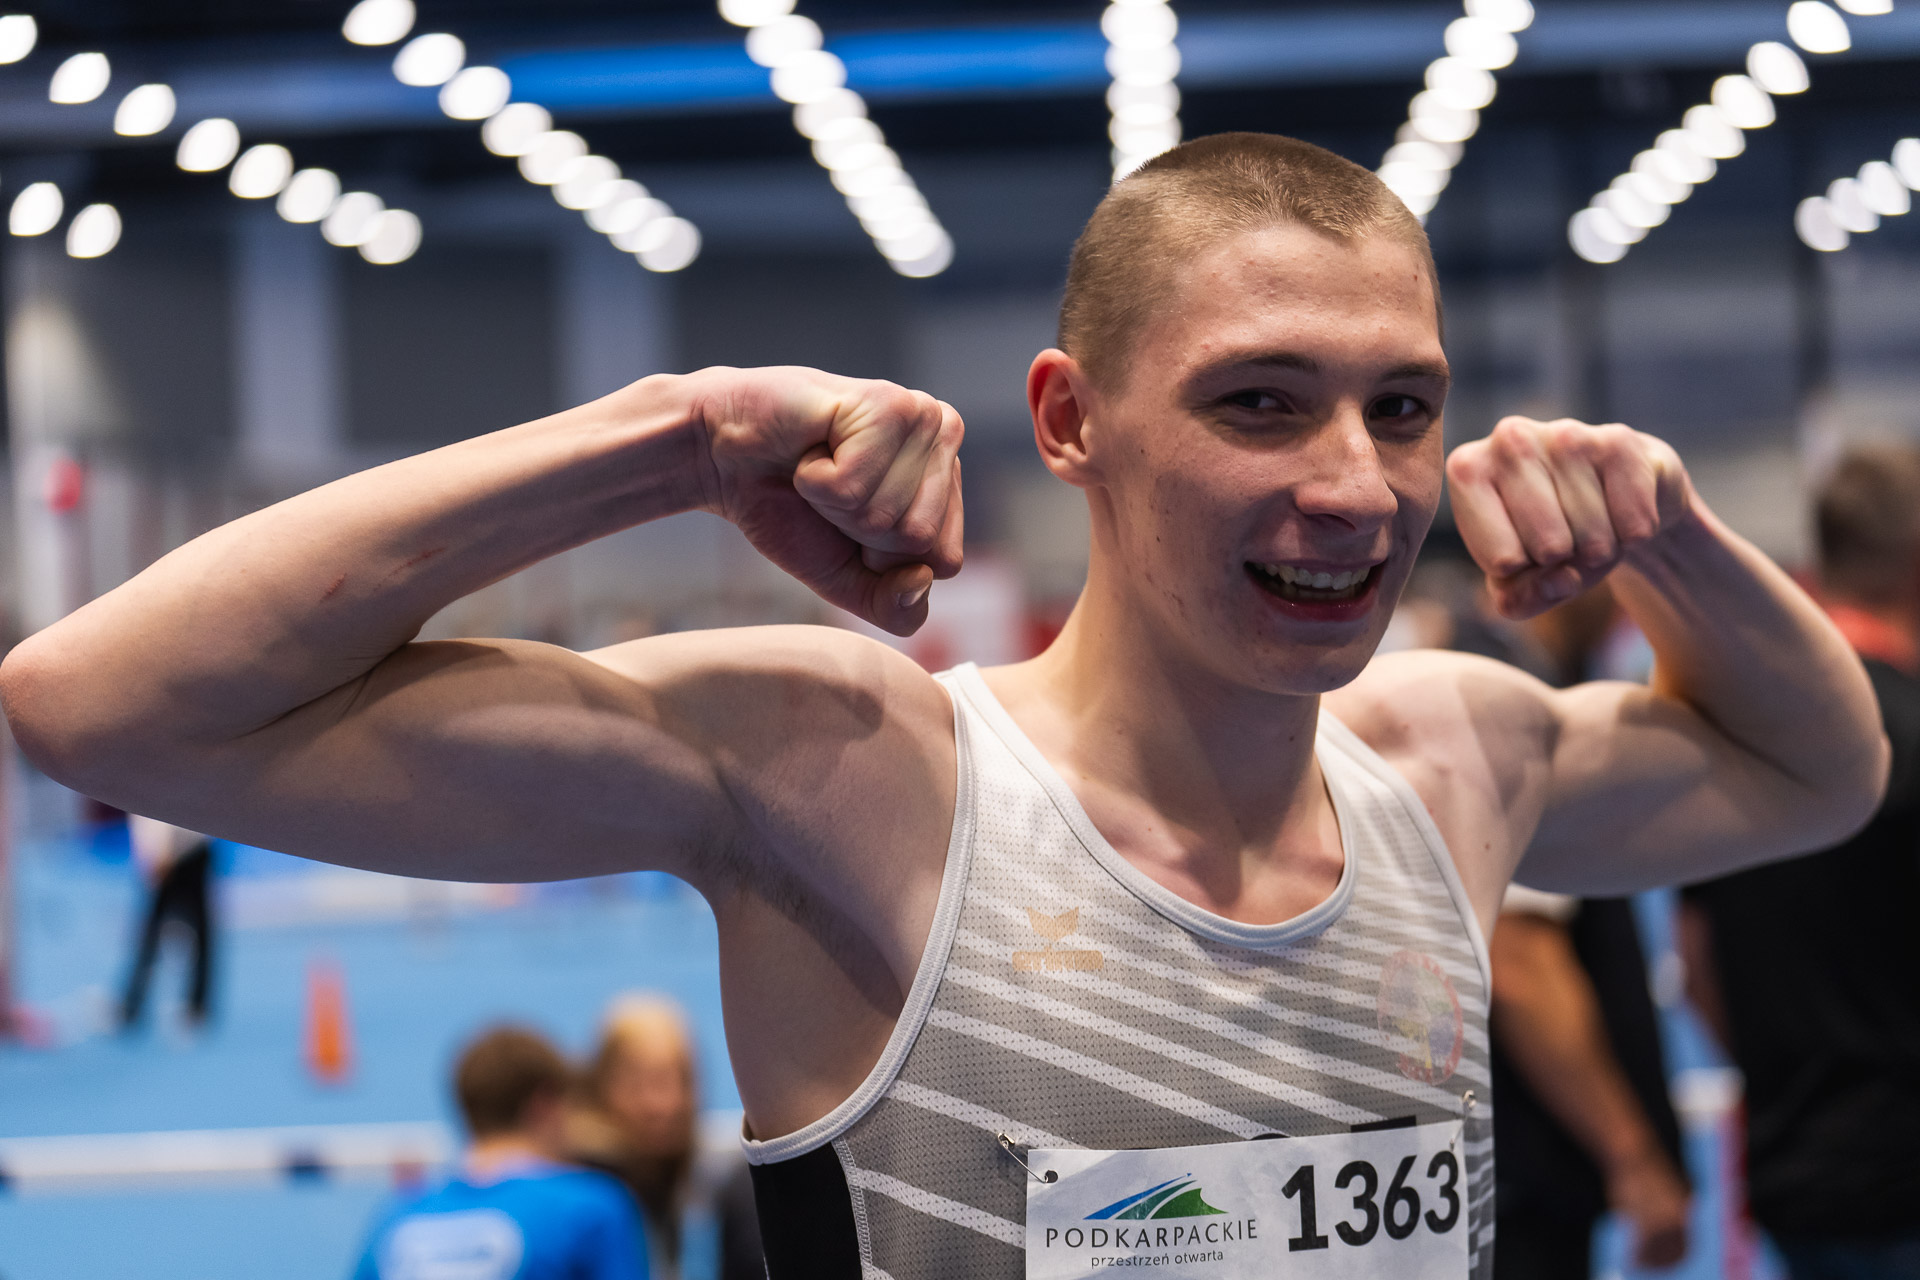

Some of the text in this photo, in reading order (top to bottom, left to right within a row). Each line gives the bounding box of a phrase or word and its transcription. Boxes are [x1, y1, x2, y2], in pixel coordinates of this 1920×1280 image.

[1281, 1150, 1461, 1252] 1363
[1046, 1218, 1258, 1249] PODKARPACKIE
[1091, 1250, 1224, 1269] przestrzeń otwarta
